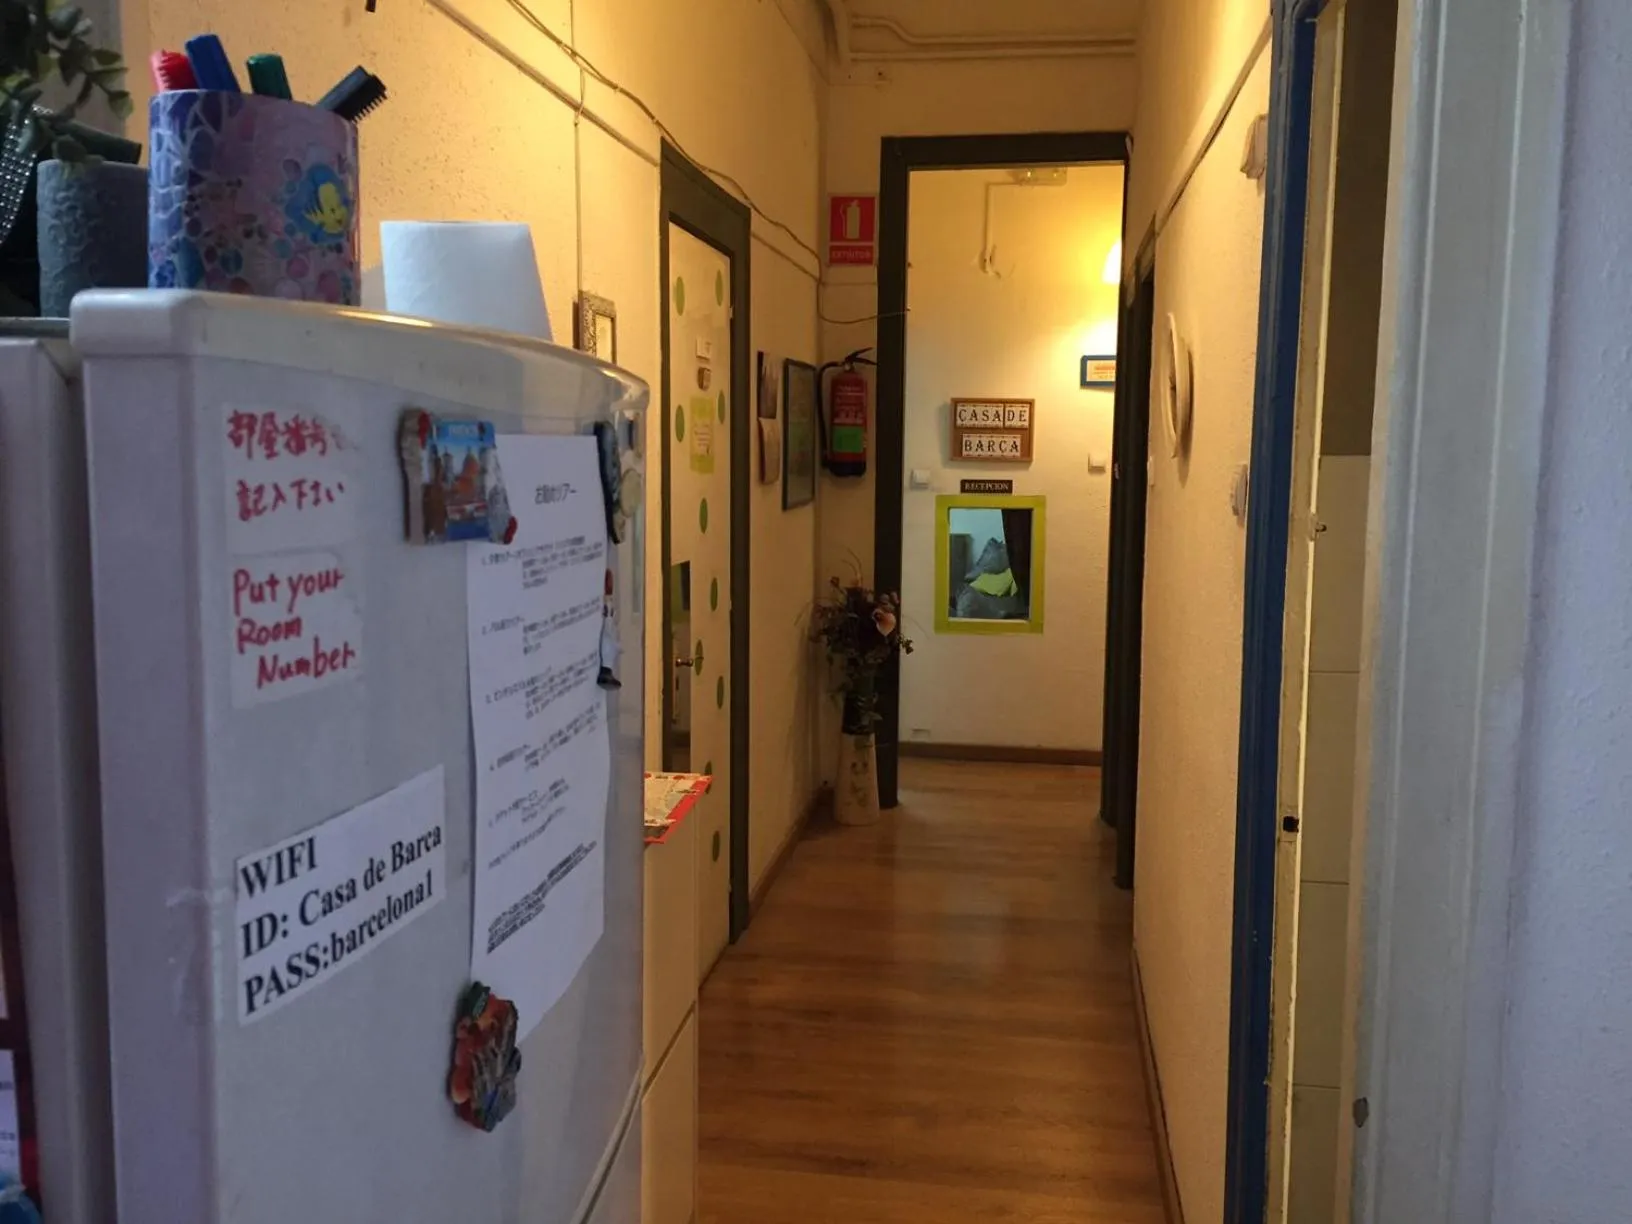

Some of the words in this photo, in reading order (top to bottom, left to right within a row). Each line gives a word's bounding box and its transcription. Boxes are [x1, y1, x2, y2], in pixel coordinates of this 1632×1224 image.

[959, 408, 1001, 422] CASA
[1007, 409, 1027, 422] DE
[236, 479, 345, 521] 記入下さい
[234, 569, 281, 616] Put
[287, 567, 345, 615] your
[237, 617, 303, 654] Room
[257, 635, 355, 689] Number
[240, 836, 317, 898] WIFI
[241, 912, 289, 959] ID:
[298, 878, 357, 926] Casa
[363, 857, 386, 892] de
[390, 825, 442, 875] Barca
